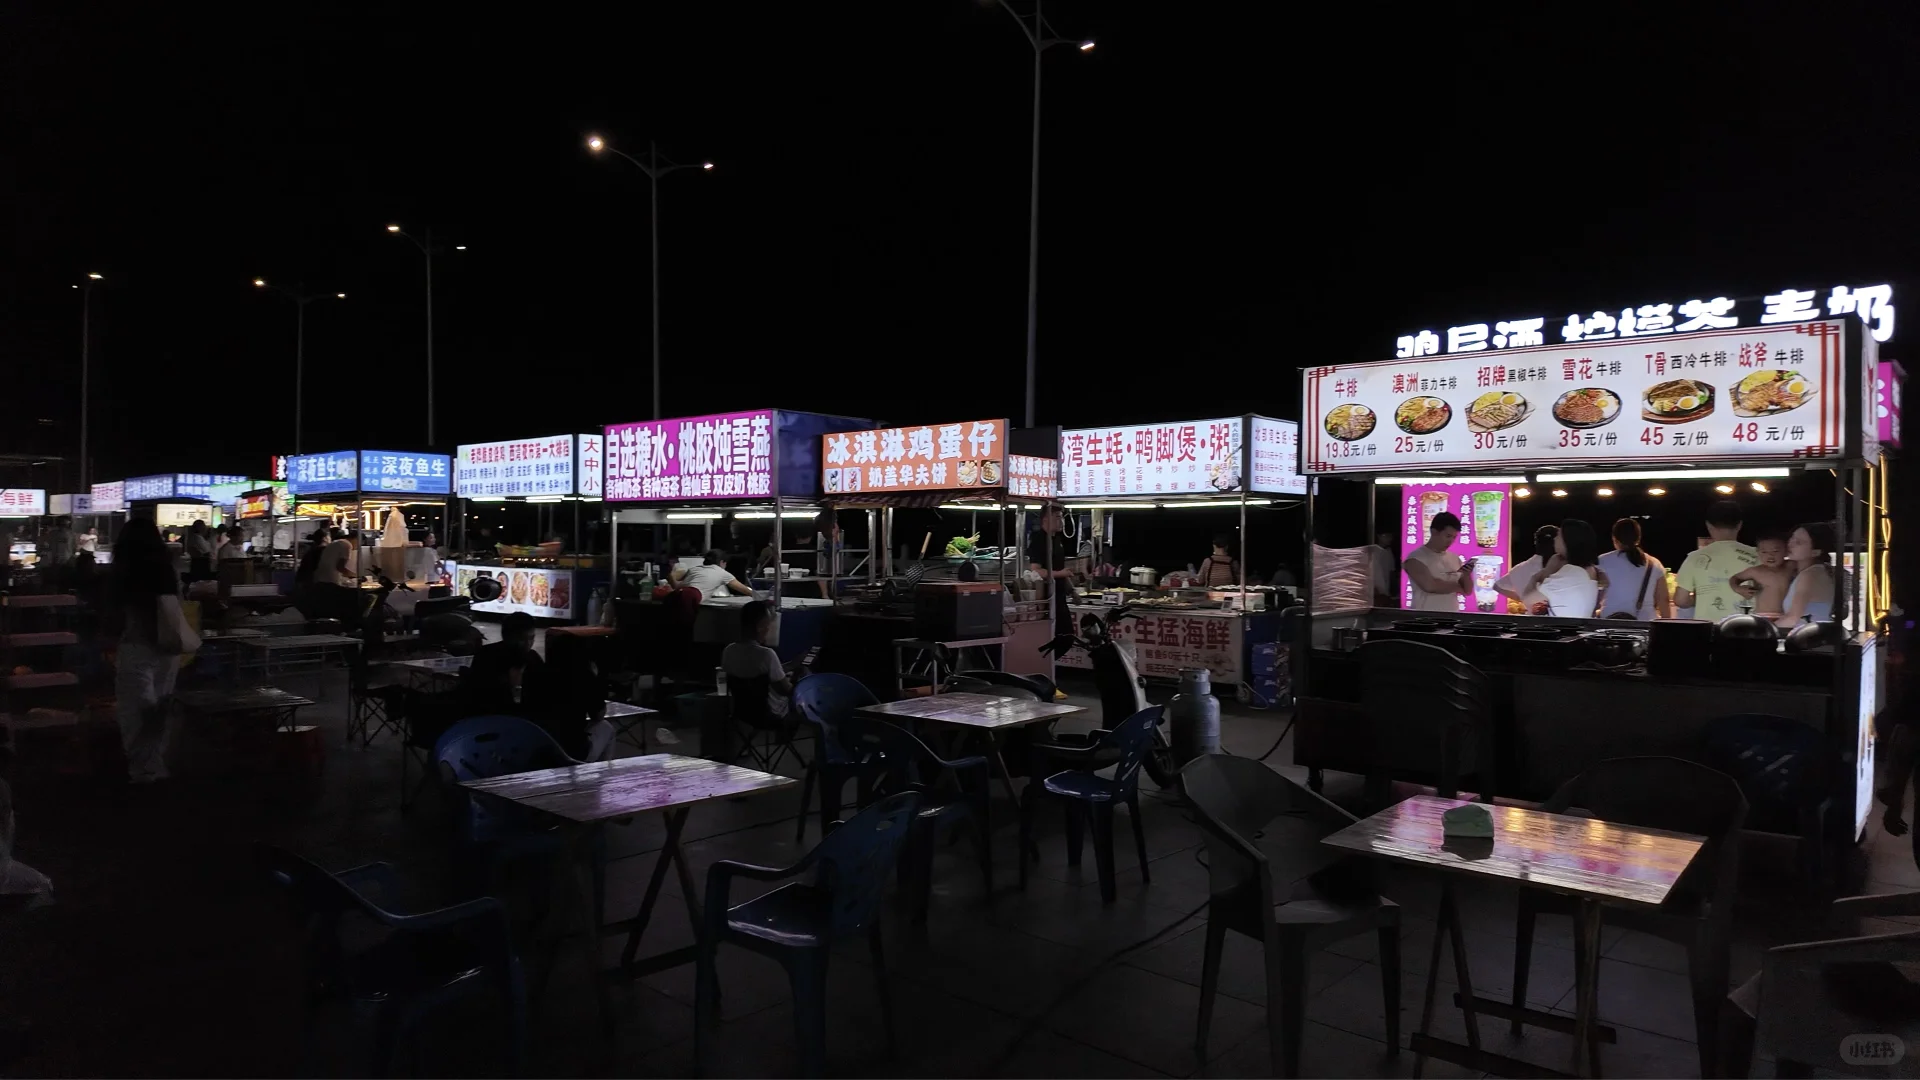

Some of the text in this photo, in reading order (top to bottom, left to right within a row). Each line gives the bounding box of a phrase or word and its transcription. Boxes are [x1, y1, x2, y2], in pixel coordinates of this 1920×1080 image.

[1334, 377, 1358, 398] 牛排
[826, 421, 998, 466] 冰淇淋鸡蛋仔
[1394, 436, 1444, 454] 25元/份
[1474, 431, 1527, 450] 30元/份
[1559, 427, 1617, 448] 35元/份
[1325, 440, 1377, 458] 19.8元/份
[297, 455, 336, 483] 深夜鱼生
[381, 456, 446, 477] 深夜鱼生
[868, 462, 947, 488] 奶盖华夫饼
[605, 478, 641, 499] 各种奶茶
[681, 473, 711, 497] 烧仙草
[712, 472, 745, 496] 双皮奶
[747, 471, 770, 495] 桃胶
